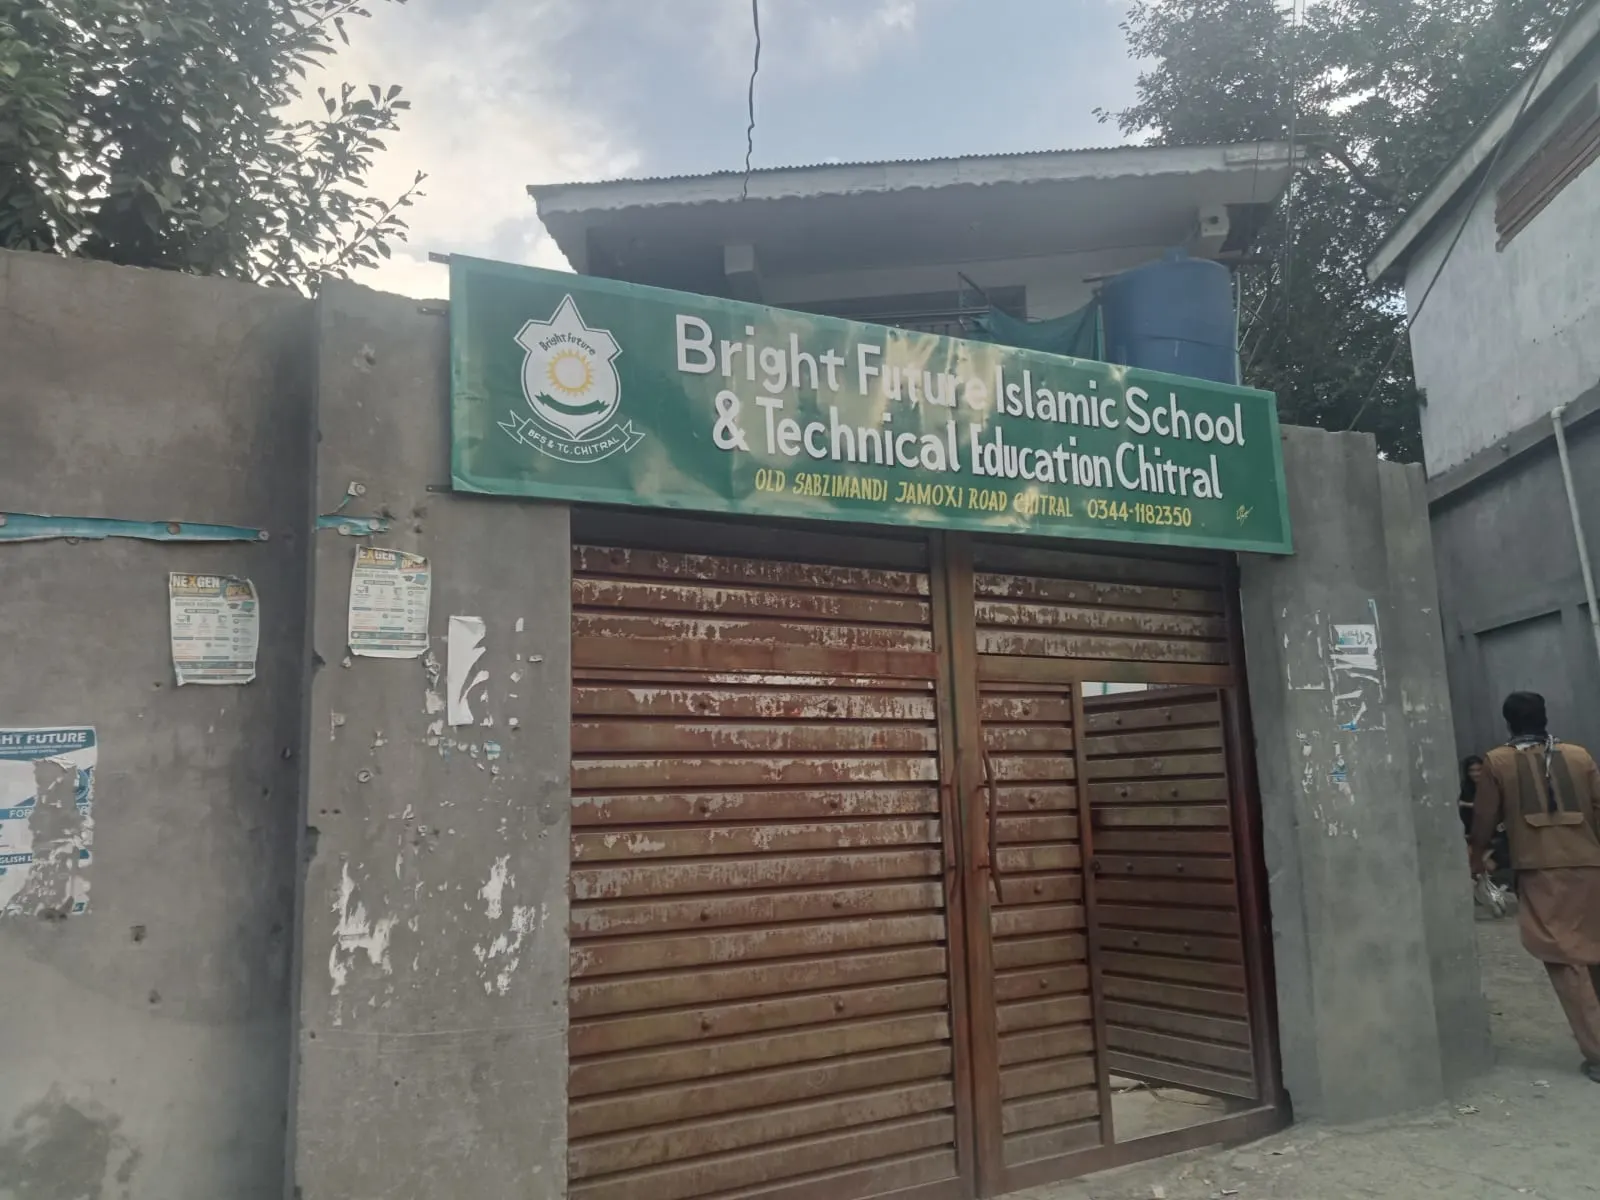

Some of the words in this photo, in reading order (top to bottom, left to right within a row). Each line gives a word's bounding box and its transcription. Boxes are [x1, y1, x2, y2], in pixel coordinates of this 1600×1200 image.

[538, 333, 567, 351] Bright
[675, 314, 845, 394] Bright
[857, 343, 988, 410] Future
[995, 364, 1119, 428] Islamic
[1125, 386, 1245, 446] School
[527, 429, 546, 444] BFS
[547, 441, 555, 449] &
[574, 436, 620, 456] CHITRAL
[713, 389, 750, 451] &
[755, 396, 961, 472] Technical
[970, 422, 1113, 488] Education
[1115, 441, 1223, 499] Chitral
[755, 468, 786, 492] OLD
[792, 472, 888, 502] SABZIMANDI
[968, 487, 1007, 512] ROAD
[1013, 491, 1074, 518] CHITRAL
[1087, 498, 1192, 528] 0344-1182350
[0, 734, 22, 745] HT
[26, 732, 87, 744] FUTURE
